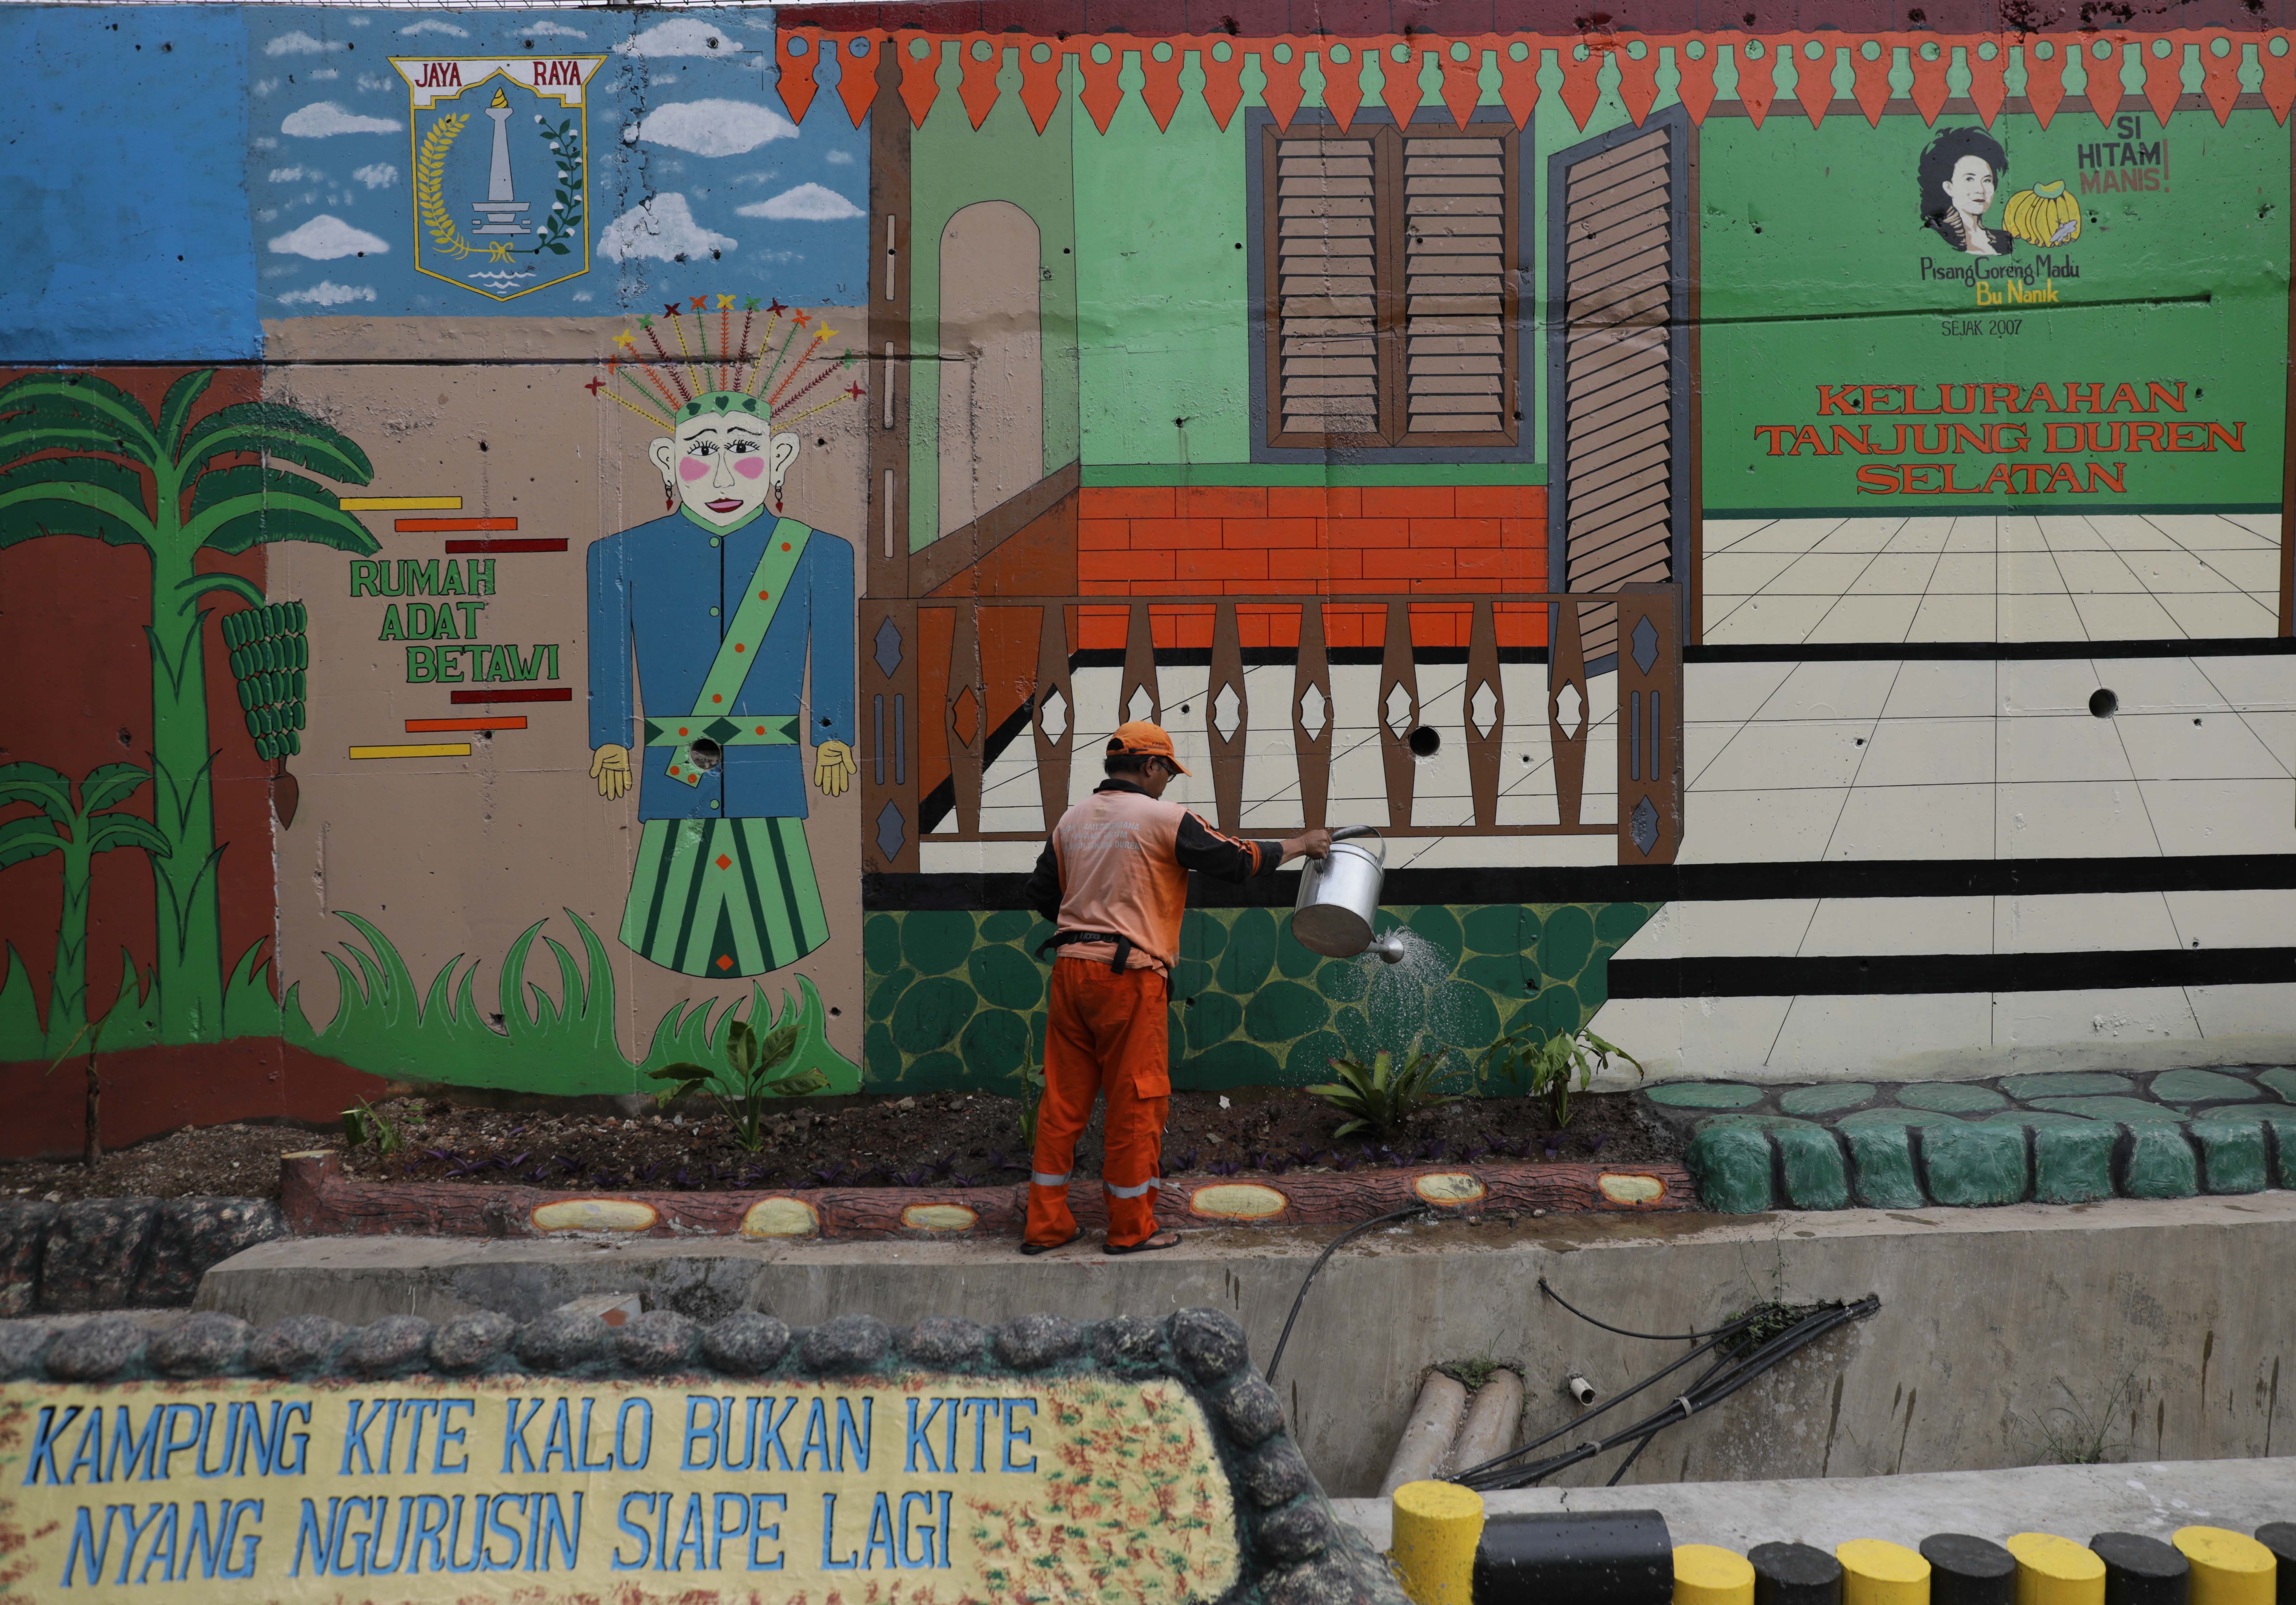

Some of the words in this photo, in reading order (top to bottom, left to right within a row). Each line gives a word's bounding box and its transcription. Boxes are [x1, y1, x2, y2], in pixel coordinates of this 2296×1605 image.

[415, 62, 462, 87] JAYA
[533, 61, 581, 86] RAYA
[2117, 116, 2141, 139] SI
[2078, 142, 2161, 169] HITAM
[2036, 254, 2080, 278] Madu
[1976, 281, 2002, 306] Bu
[2008, 279, 2059, 304] Nanik
[1941, 320, 1984, 336] SEJAK
[1989, 319, 2023, 335] 2007
[1816, 382, 2188, 415] KELURAHAN
[1754, 423, 2032, 456] TANJUNG
[2043, 421, 2247, 452] DUREN
[1857, 462, 2127, 495] SELATAN
[350, 559, 496, 597] RUMAH
[378, 602, 485, 640] ADAT
[406, 644, 559, 682] BETAWI
[1115, 840, 1140, 850] DUREN
[22, 1399, 311, 1485] KAMPUNG
[338, 1398, 474, 1476] KITE
[500, 1396, 652, 1473] KALO
[679, 1394, 873, 1473] BUKAN
[903, 1396, 1037, 1474] KITE
[60, 1498, 264, 1587] NYANG
[288, 1491, 583, 1577] NGURUSIN
[611, 1491, 787, 1572] SIAPE
[820, 1491, 952, 1571] LAGI
